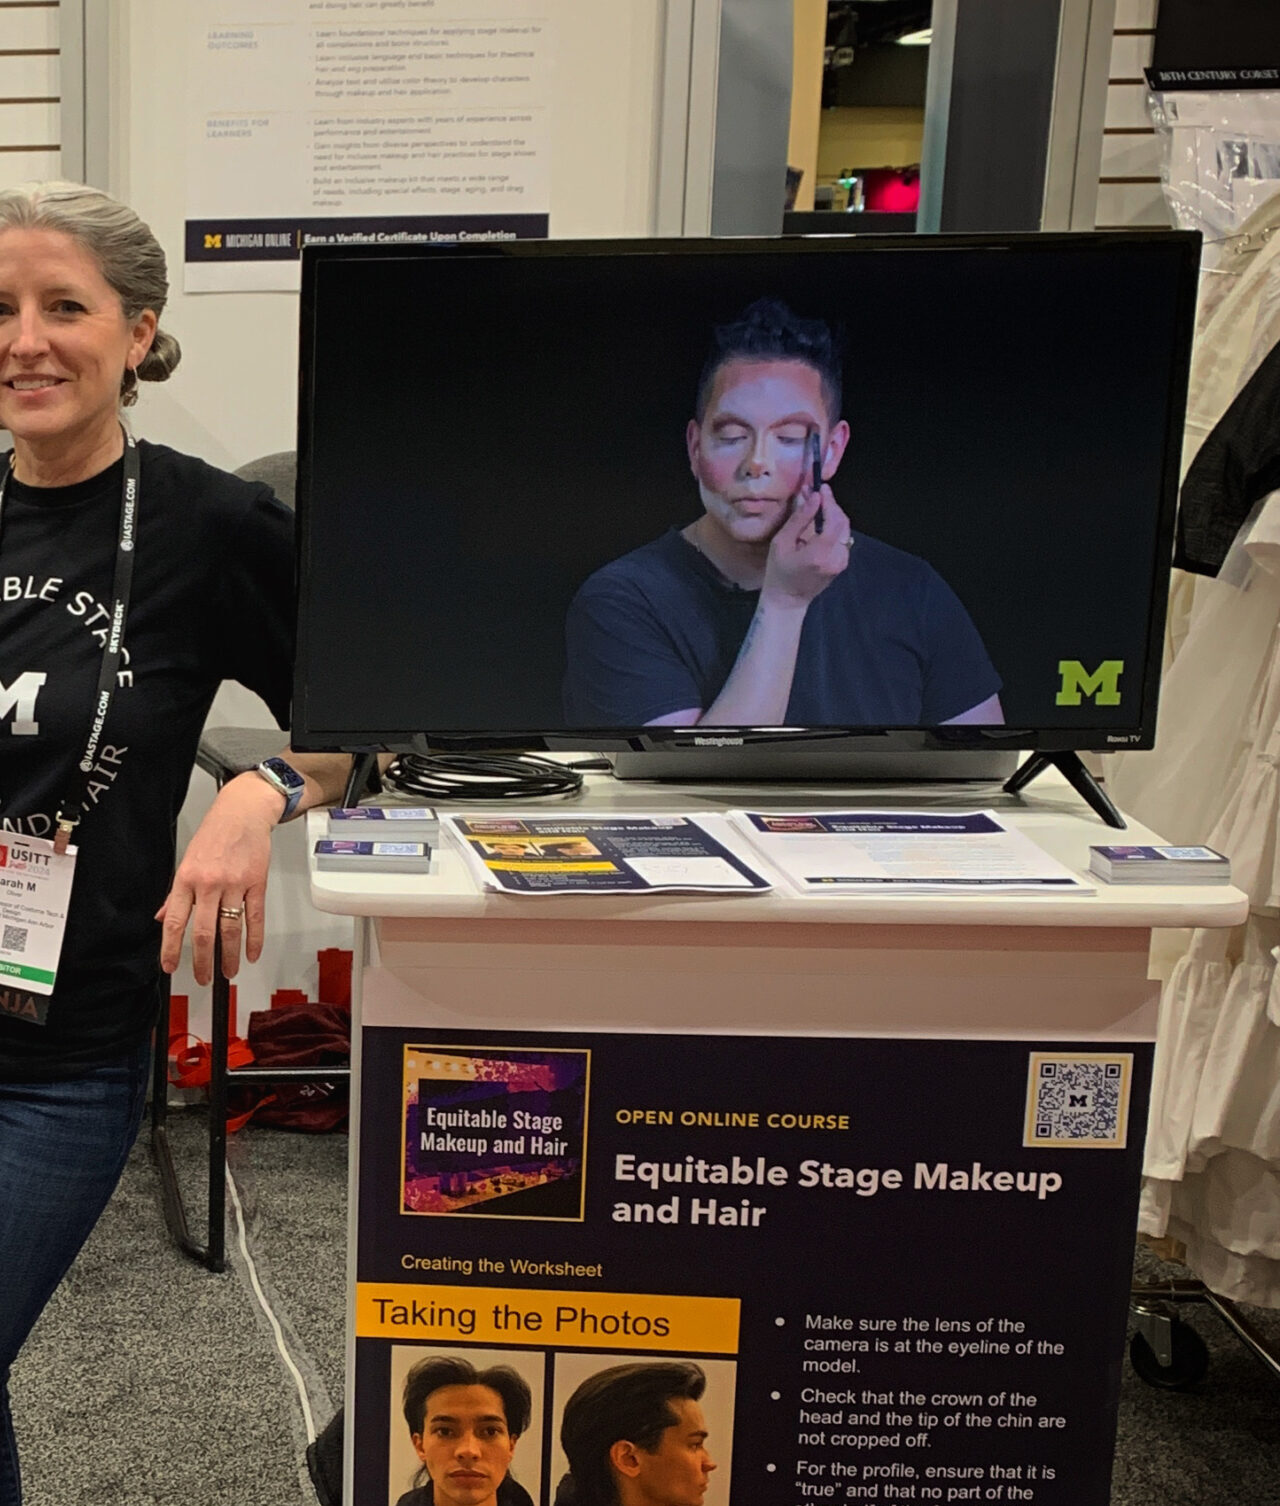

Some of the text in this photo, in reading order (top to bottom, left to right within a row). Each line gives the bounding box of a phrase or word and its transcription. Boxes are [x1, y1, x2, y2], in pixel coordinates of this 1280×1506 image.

[1187, 71, 1237, 81] CENTURY
[1240, 69, 1279, 79] CORSET
[204, 234, 222, 248] M
[226, 233, 264, 247] MICHIGAN
[265, 233, 292, 247] ONLINE
[304, 233, 327, 243] Earn
[336, 231, 375, 242] Verified
[378, 231, 427, 241] Certificate
[430, 231, 457, 241] Upon
[459, 230, 516, 240] Completion
[1055, 660, 1124, 706] M
[11, 848, 52, 866] USITT
[26, 881, 36, 892] M
[427, 1107, 562, 1134] Equitable Stage
[616, 1110, 849, 1129] OPEN ONLINE COURSE
[421, 1132, 568, 1156] Makeup and Hair
[615, 1154, 1062, 1199] Equitable Stage Makeup
[612, 1196, 766, 1226] and Hair
[401, 1255, 602, 1277] Creating the Worksheet
[373, 1299, 669, 1336] Taking the Photos
[806, 1314, 1025, 1333] Make sure the lens of the
[804, 1338, 1064, 1357] camera is at the eyeline of the
[803, 1359, 860, 1373] model.
[801, 1388, 1037, 1407] Check that the crown of the
[800, 1409, 1066, 1429] head and the tip of the chin are
[799, 1432, 931, 1449] not cropped off.
[797, 1461, 1055, 1480] For the profile, ensure that it is
[846, 1484, 878, 1497] and
[884, 1484, 915, 1498] that
[921, 1488, 942, 1498] no
[948, 1486, 981, 1502] part
[986, 1485, 1003, 1499] of
[1008, 1486, 1033, 1500] the
